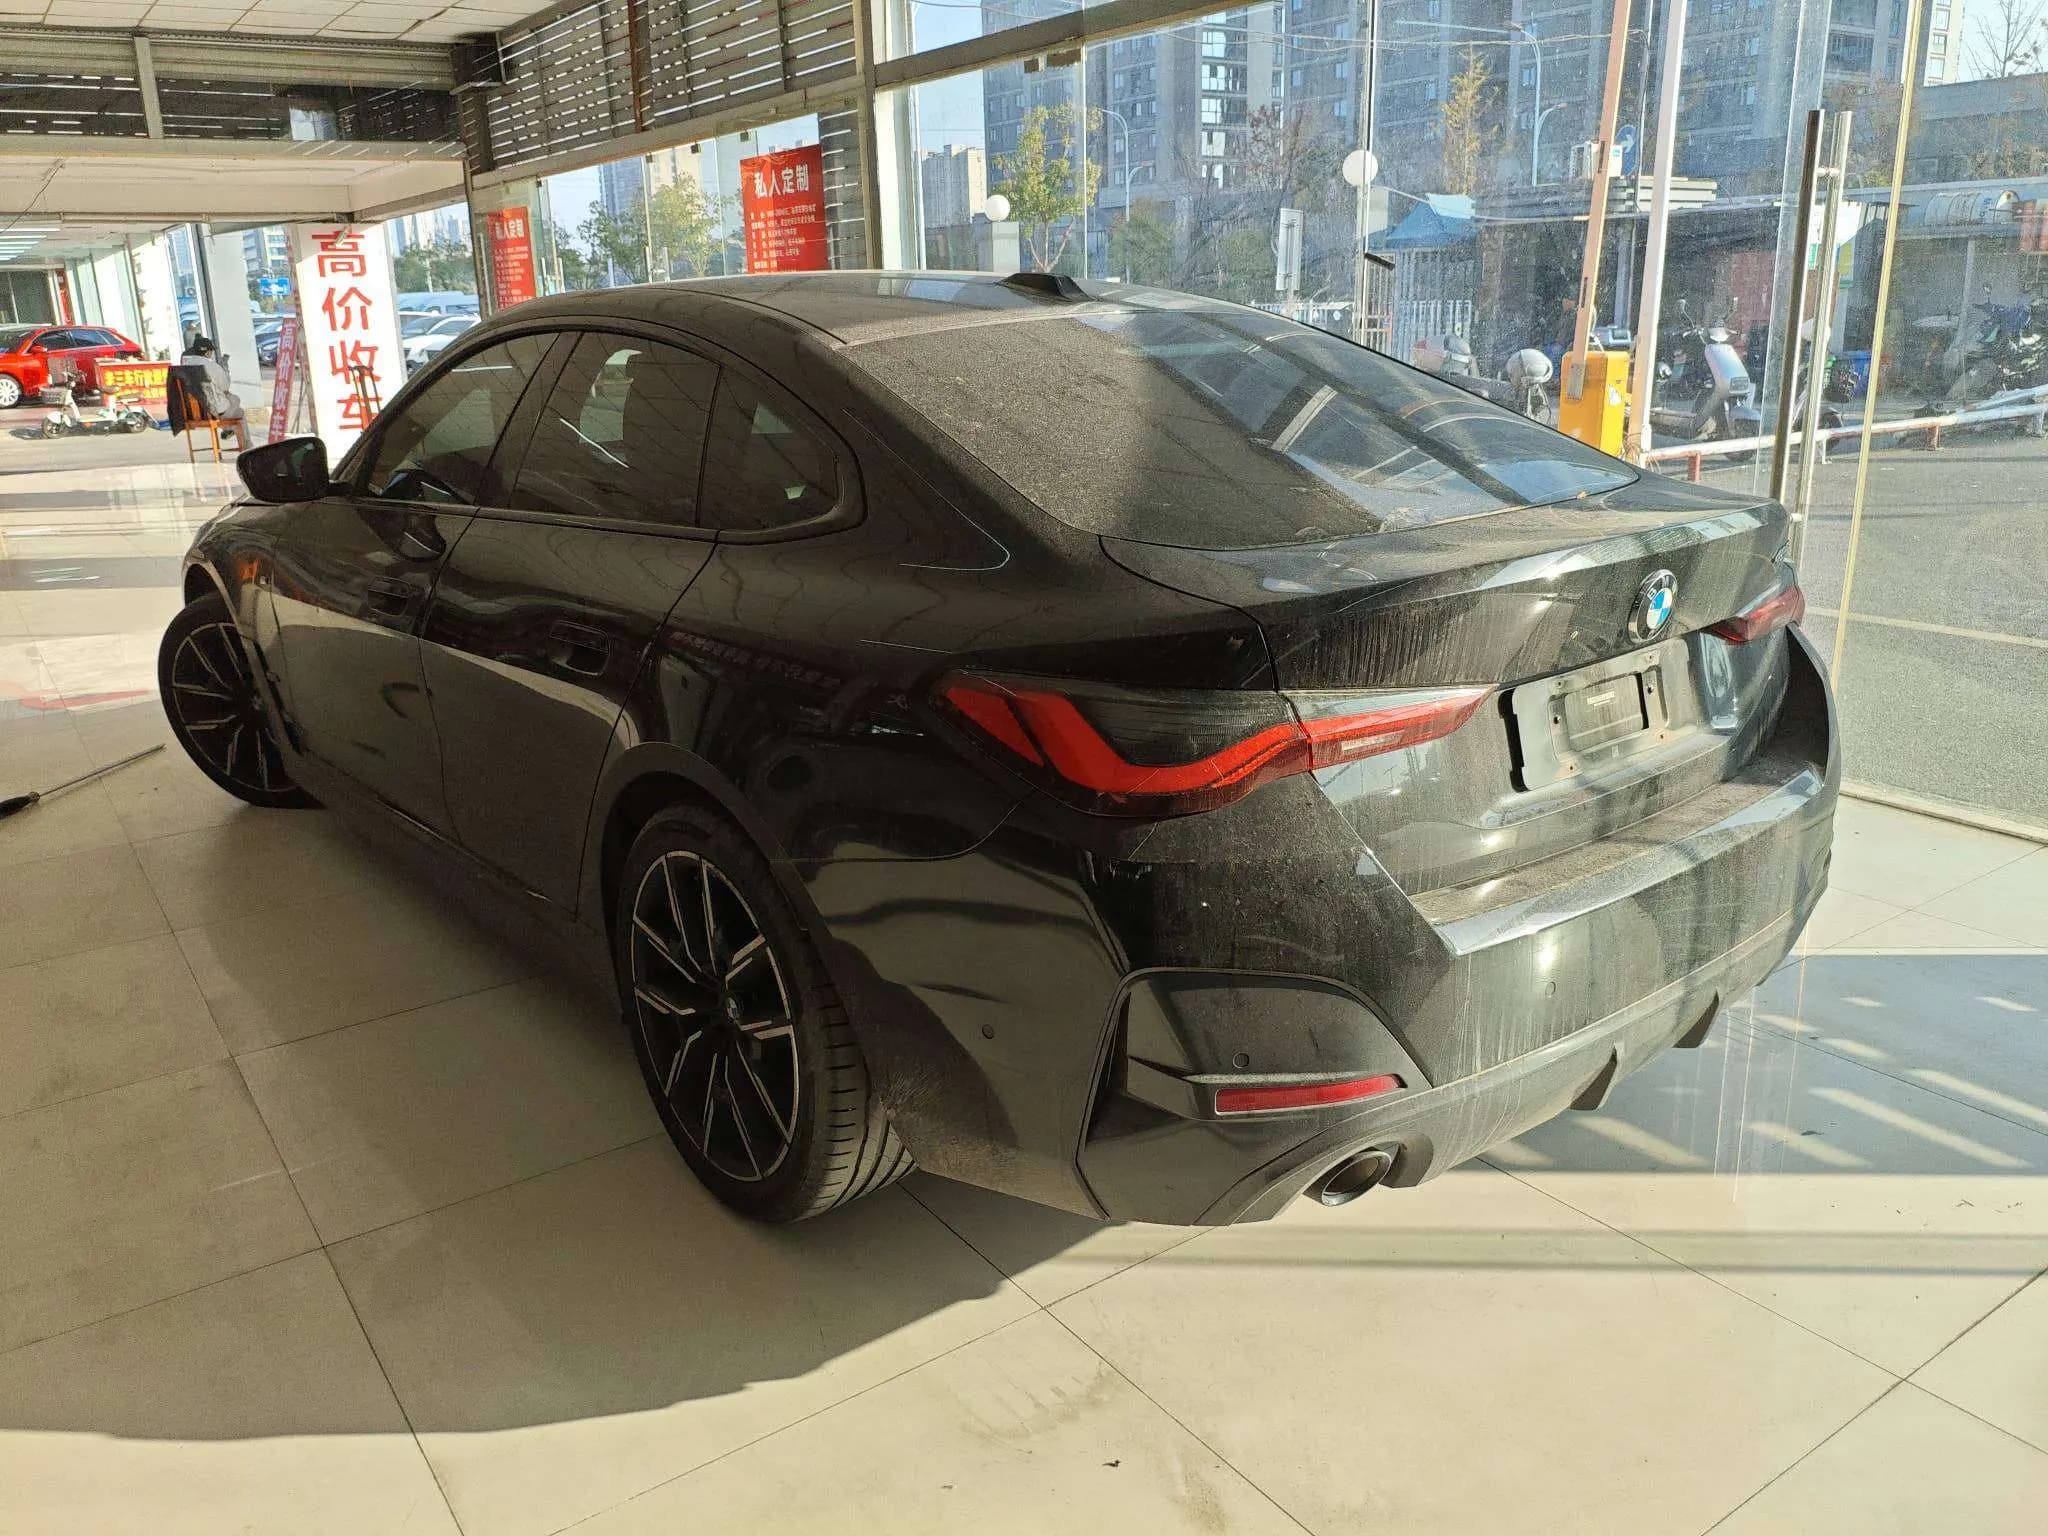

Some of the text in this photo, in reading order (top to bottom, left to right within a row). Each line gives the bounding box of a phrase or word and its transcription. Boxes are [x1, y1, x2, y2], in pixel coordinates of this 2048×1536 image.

[755, 164, 809, 198] 私人定制
[312, 231, 383, 430] 高价收车
